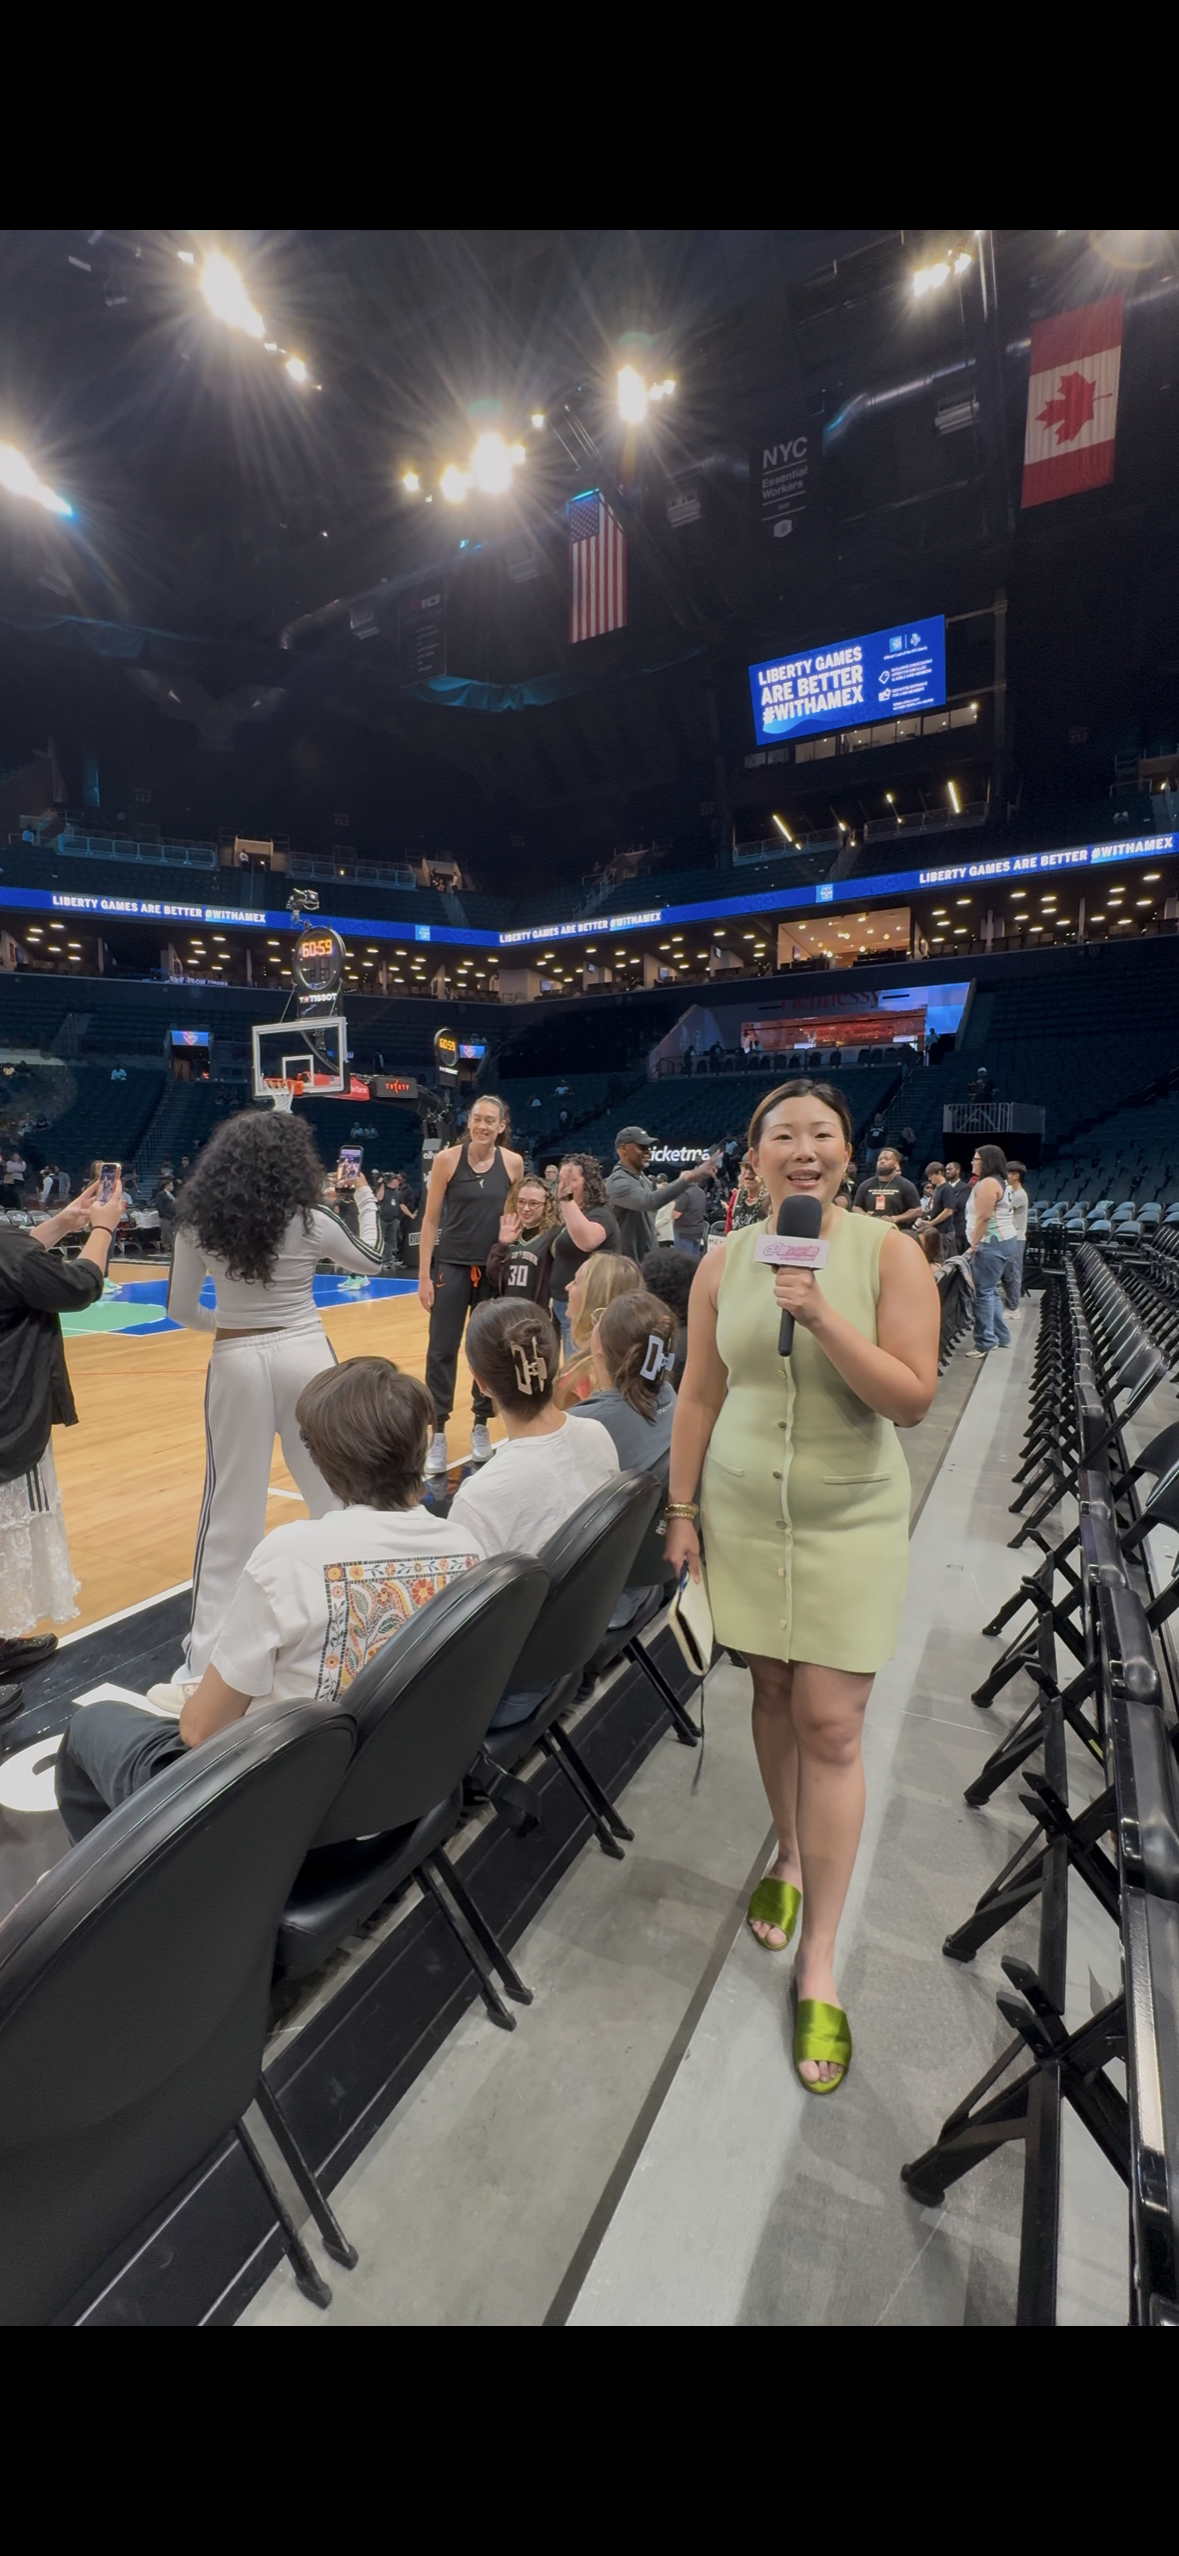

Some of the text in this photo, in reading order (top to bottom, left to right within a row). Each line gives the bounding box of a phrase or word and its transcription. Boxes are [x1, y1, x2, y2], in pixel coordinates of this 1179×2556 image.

[763, 436, 807, 469] NYC
[762, 466, 808, 489] Essential
[762, 480, 803, 499] Workers
[758, 659, 812, 686] LIBERTY
[815, 646, 863, 671] GAMES
[761, 679, 793, 706] ARE
[797, 664, 864, 698] BETTER
[762, 685, 864, 724] #WITHAMEX
[919, 836, 1173, 884] LIBERTY GAMES ARE BETTER #WITHAMEX
[52, 895, 98, 909] LIBERTY
[101, 899, 139, 912] GAMES
[140, 903, 161, 914] ARE
[163, 905, 202, 918] BETTER
[499, 930, 532, 943] LIBERTY
[532, 927, 559, 939] GAMES
[560, 924, 576, 935] ARE
[578, 920, 608, 933] BETTER
[648, 1145, 711, 1161] icketma
[508, 1265, 528, 1286] 30
